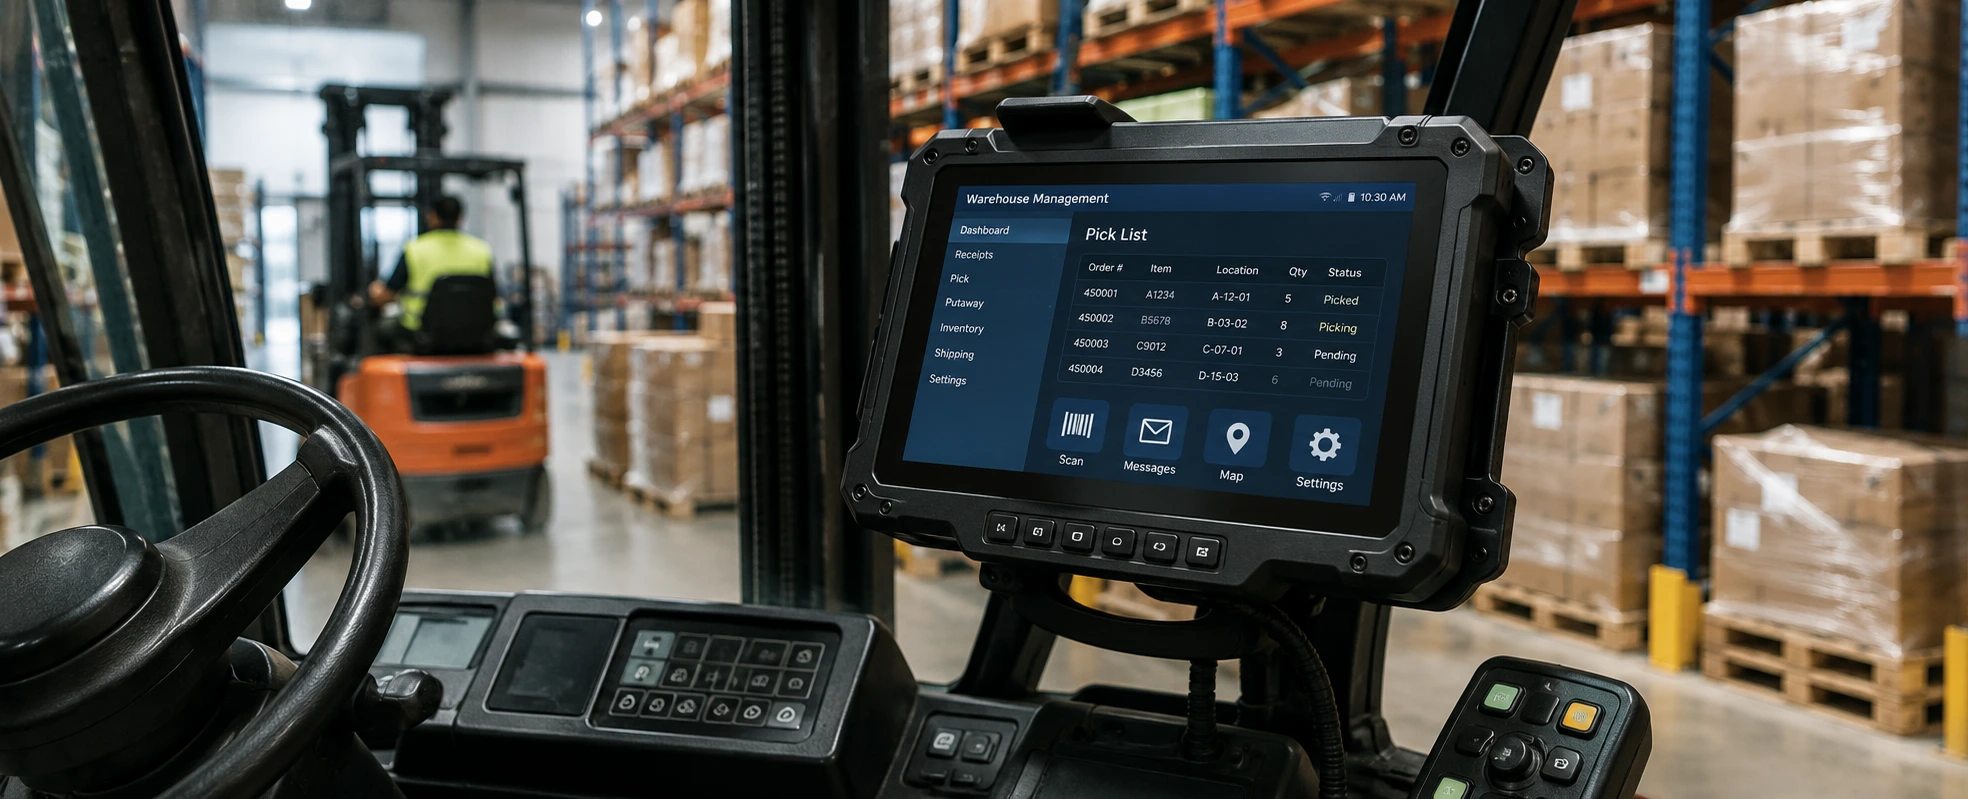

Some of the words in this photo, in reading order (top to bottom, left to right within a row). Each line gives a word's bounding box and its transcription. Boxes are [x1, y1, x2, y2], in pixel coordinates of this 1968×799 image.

[966, 193, 1030, 205] Warehouse
[1032, 193, 1110, 207] Management
[1388, 192, 1407, 202] AM
[959, 225, 1010, 235] Dashboard
[1085, 227, 1116, 241] Pick
[1120, 228, 1147, 241] List
[954, 249, 994, 261] Receipts
[1088, 262, 1115, 272] Order
[1116, 263, 1124, 272] #
[1150, 263, 1172, 273] Item
[1216, 265, 1259, 275] Location
[1288, 266, 1308, 279] Qty
[1328, 267, 1362, 278] Status
[949, 273, 970, 284] Pick
[944, 297, 985, 311] Putaway
[1083, 288, 1118, 298] 450001
[1145, 289, 1175, 300] A1234
[1211, 291, 1251, 302] A-12-01
[1284, 293, 1292, 304] 5
[1323, 294, 1360, 306] Picked
[939, 322, 985, 336] Inventory
[1078, 312, 1114, 323] 450002
[1140, 315, 1171, 326] B5678
[1206, 317, 1248, 329] B-03-02
[1280, 320, 1288, 331] 8
[1318, 321, 1358, 336] Picking
[934, 347, 975, 362] Shipping
[1073, 338, 1109, 349] 450003
[1136, 340, 1167, 352] C9012
[1202, 343, 1243, 356] C-07-01
[1275, 347, 1283, 358] 3
[1314, 349, 1357, 364] Pending
[929, 373, 967, 388] Settings
[1068, 363, 1104, 374] 450004
[1131, 366, 1163, 378] D3456
[1198, 370, 1239, 382] D-15-03
[1271, 374, 1279, 385] 6
[1309, 376, 1353, 392] Pending
[1058, 453, 1084, 467] Scan
[1123, 460, 1176, 476] Messages
[1219, 469, 1244, 484] Map
[1295, 476, 1344, 493] Settings
